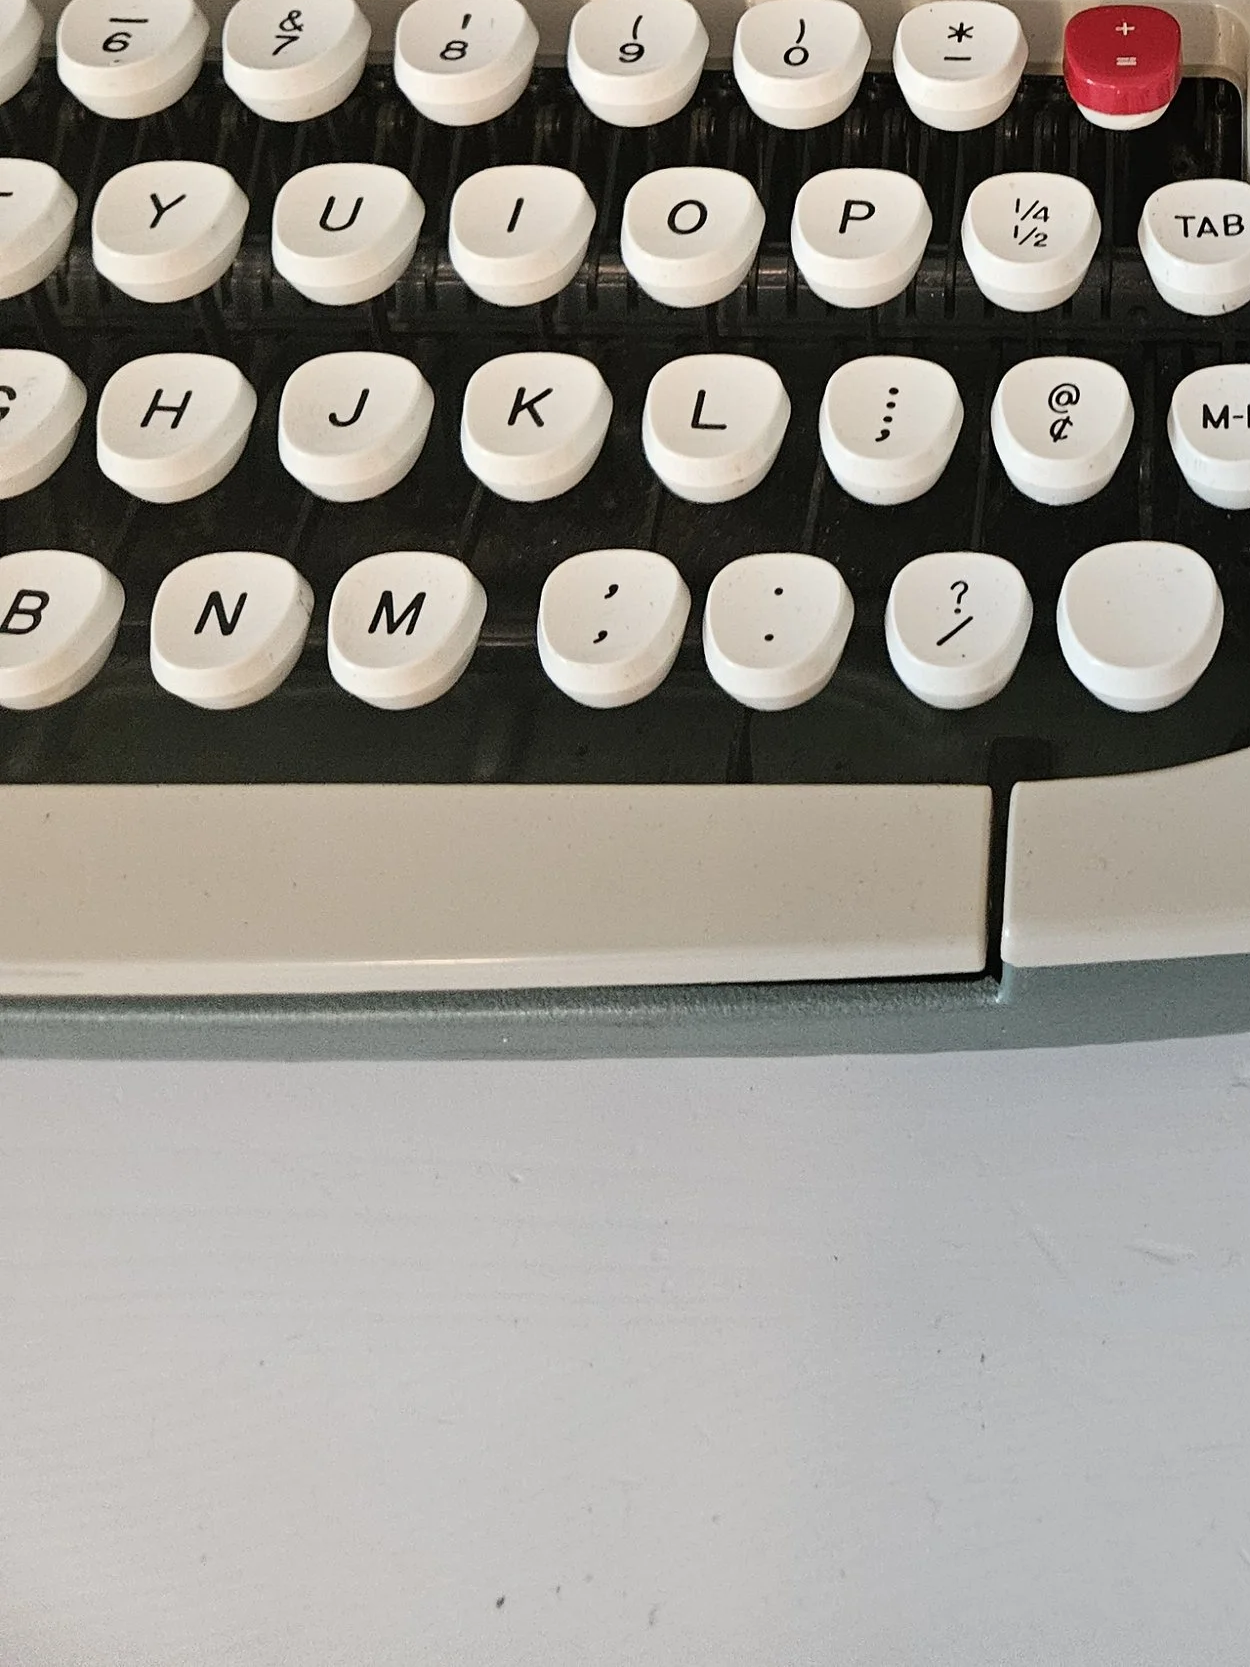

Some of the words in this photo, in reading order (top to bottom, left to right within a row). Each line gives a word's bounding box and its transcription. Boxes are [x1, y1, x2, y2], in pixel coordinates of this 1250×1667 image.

[279, 10, 303, 31] &
[102, 32, 131, 52] 6
[272, 35, 299, 55] 7
[440, 41, 468, 60] 8
[619, 43, 644, 63] 9
[150, 193, 186, 228] Y
[319, 196, 363, 231] U
[507, 198, 524, 232] I
[839, 200, 875, 234] P
[1175, 214, 1244, 238] TAB
[140, 389, 192, 429] H
[329, 389, 369, 427] J
[508, 387, 553, 427] K
[691, 390, 727, 430] L
[1048, 383, 1080, 413] @
[0, 589, 49, 635] B
[194, 591, 247, 636] N
[368, 591, 426, 635] M
[951, 581, 968, 614] ?
